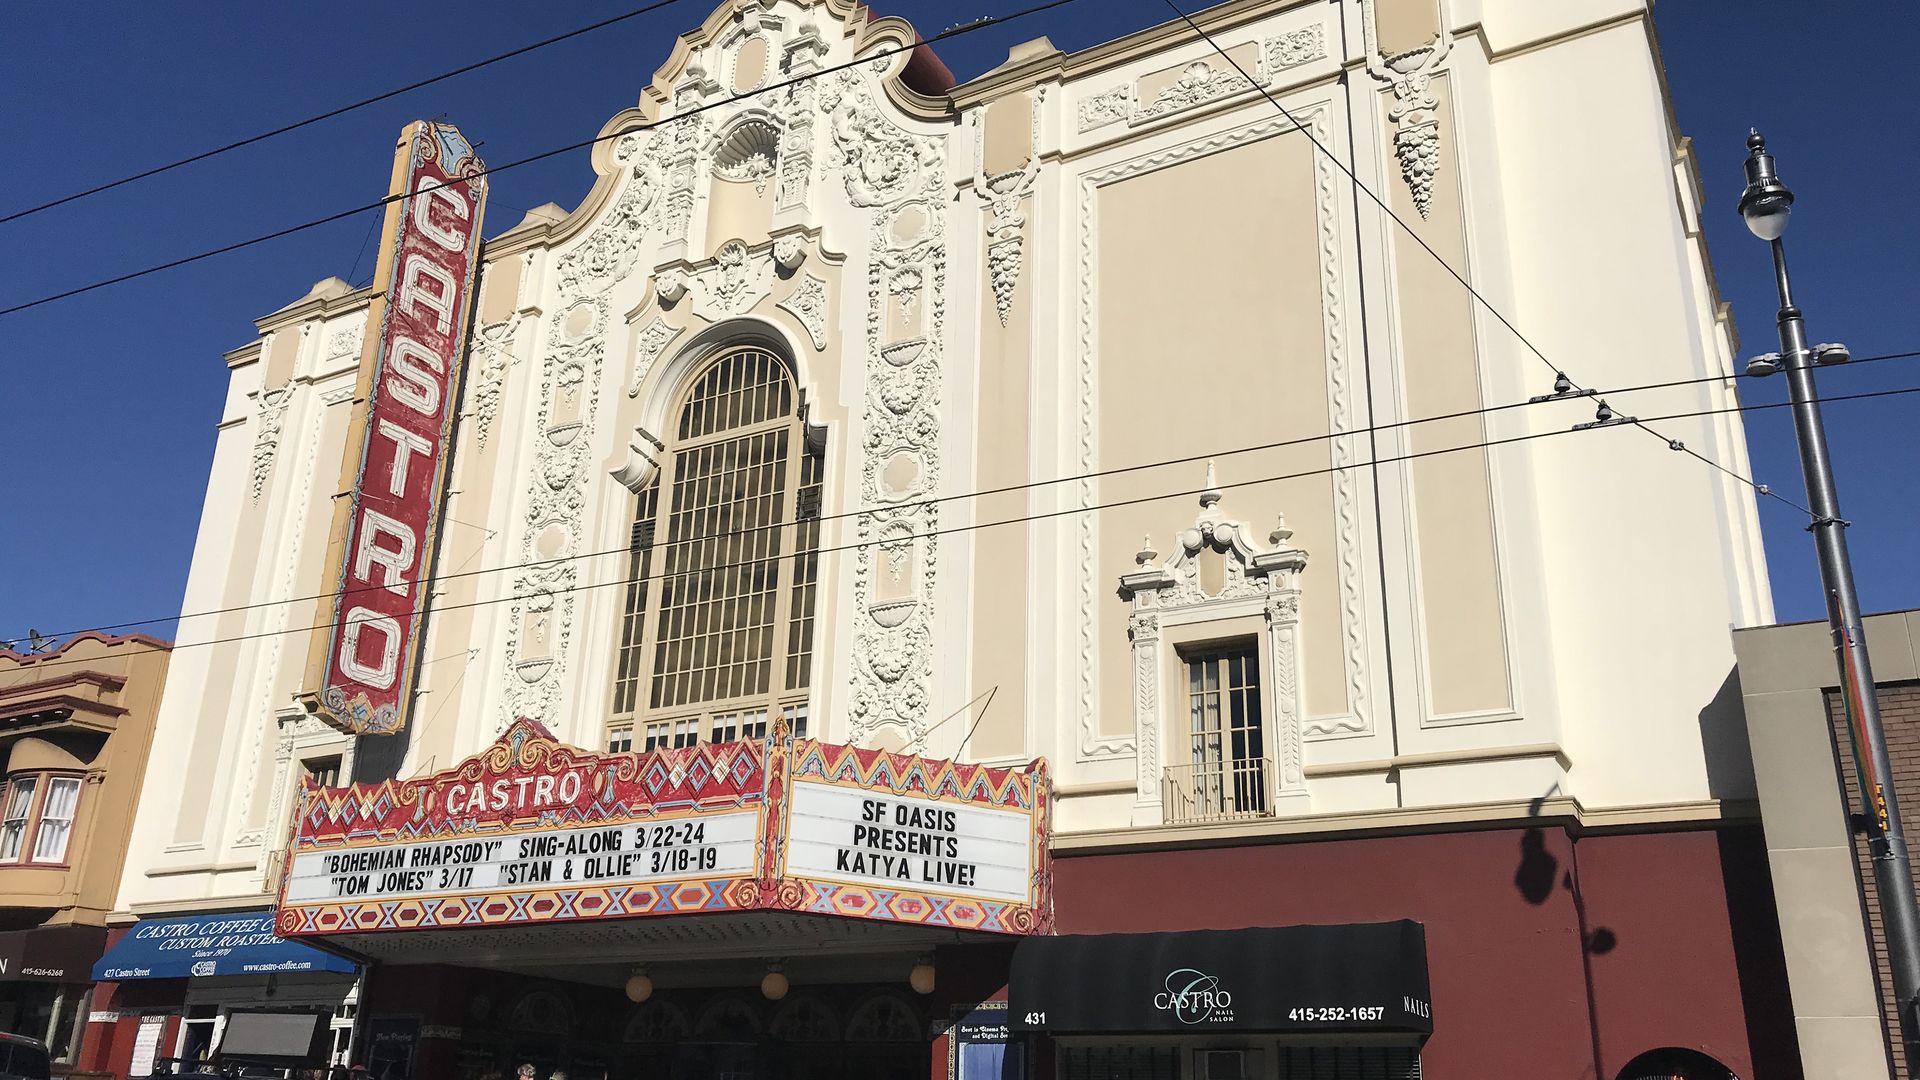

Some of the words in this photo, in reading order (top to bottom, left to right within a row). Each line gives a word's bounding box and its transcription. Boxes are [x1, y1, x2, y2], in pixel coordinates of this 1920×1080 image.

[339, 174, 469, 689] CASTRO
[446, 771, 581, 815] CASTRO
[862, 800, 886, 823] SF
[895, 804, 956, 832] OASIS
[324, 848, 406, 874] "BOHEMIAN
[410, 841, 503, 868] RHAPSODY"
[519, 830, 623, 859] SING-ALONG
[634, 822, 705, 849] 3/22-24
[853, 824, 958, 858] PRESENTS
[331, 875, 370, 896] "TOM
[376, 871, 433, 893] JONES"
[439, 868, 474, 889] 3/17
[500, 861, 552, 884] "STAN
[563, 859, 573, 880] &
[584, 853, 641, 879] OLLIE"
[651, 847, 717, 873] 3/18-19
[836, 849, 910, 880] KATYA
[923, 860, 976, 887] LIVE!
[135, 923, 200, 939] CASTRO
[199, 919, 263, 935] COFFEE
[158, 935, 218, 950] CUSTOM
[104, 969, 115, 977] 427
[114, 969, 133, 977] Castro
[133, 968, 150, 976] Street
[243, 960, 311, 972] www.castro-coffee.com
[1154, 990, 1231, 1009] CASTRO
[1403, 996, 1429, 1018] NAILS
[1024, 1012, 1047, 1025] 431
[1288, 1007, 1384, 1021] 415-252-1657
